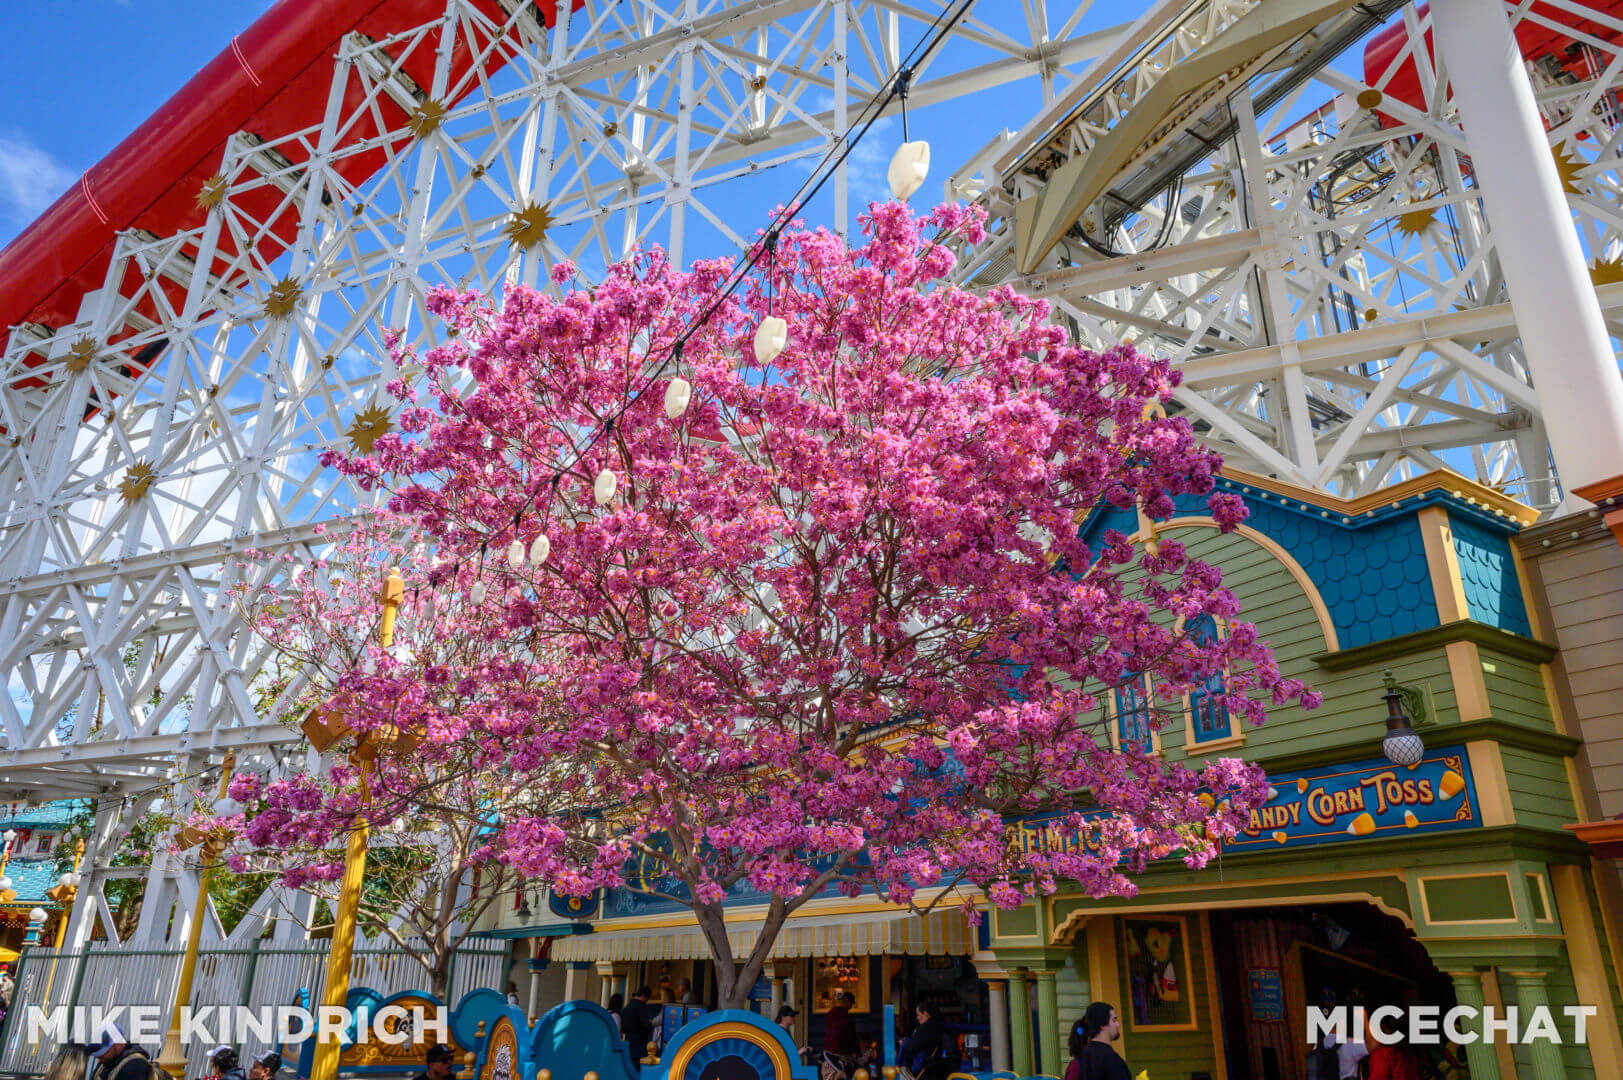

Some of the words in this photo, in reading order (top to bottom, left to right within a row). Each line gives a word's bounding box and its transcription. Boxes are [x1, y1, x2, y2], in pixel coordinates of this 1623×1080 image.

[1005, 819, 1107, 857] HEIMLIC
[1306, 786, 1367, 825] CORN
[1360, 771, 1435, 816] TOSS
